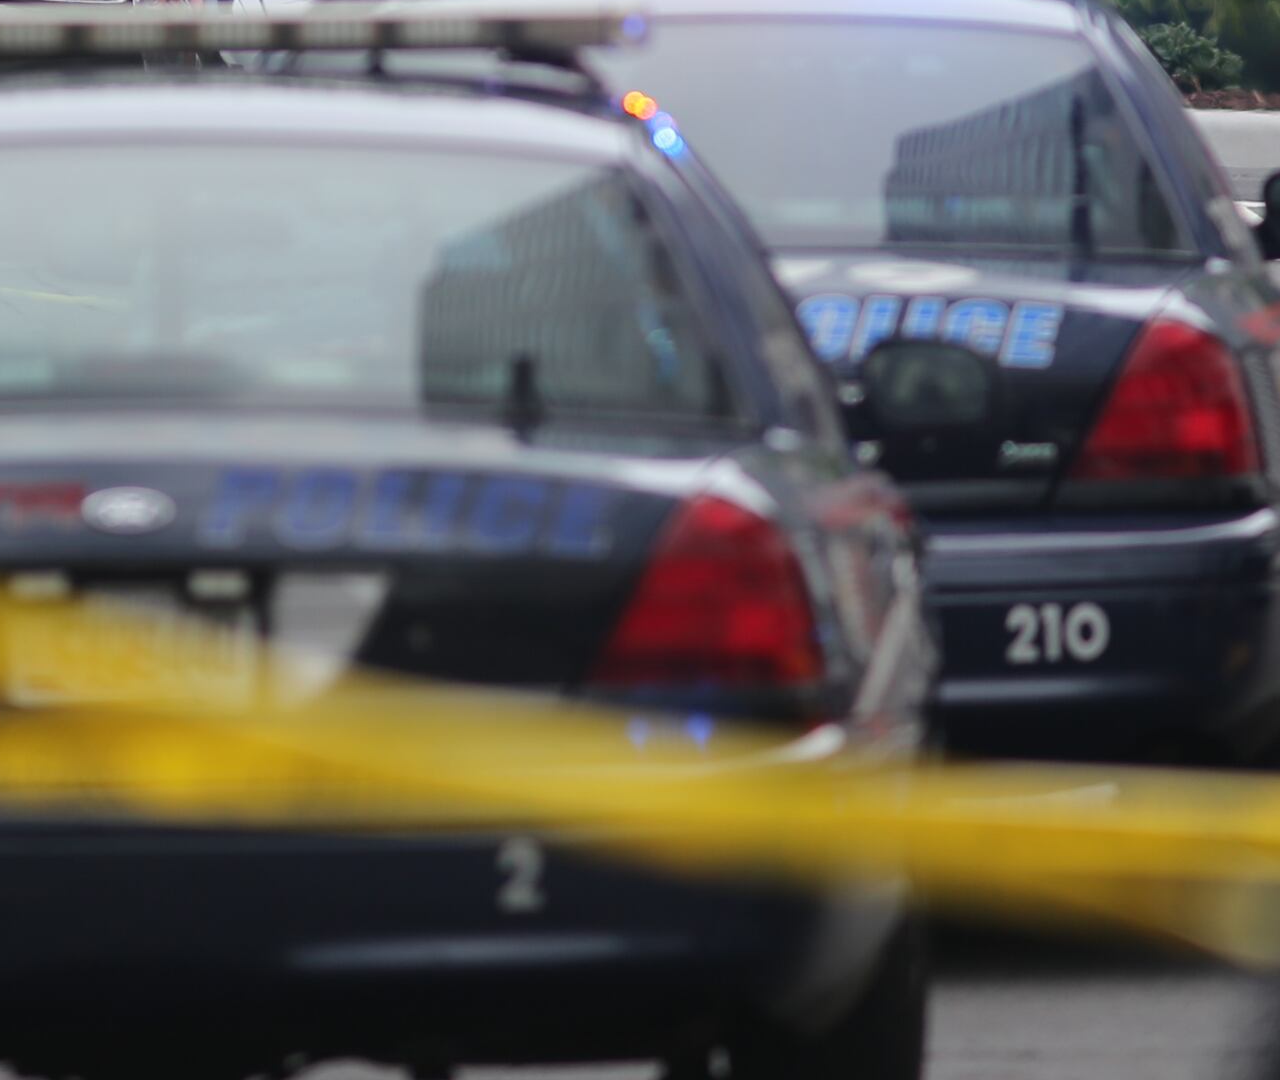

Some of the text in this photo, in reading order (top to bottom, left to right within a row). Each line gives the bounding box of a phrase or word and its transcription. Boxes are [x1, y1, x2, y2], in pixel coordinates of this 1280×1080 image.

[795, 293, 1064, 369] OLICE
[198, 463, 613, 559] POLICE
[1004, 601, 1110, 664] 210
[496, 838, 547, 913] 2
